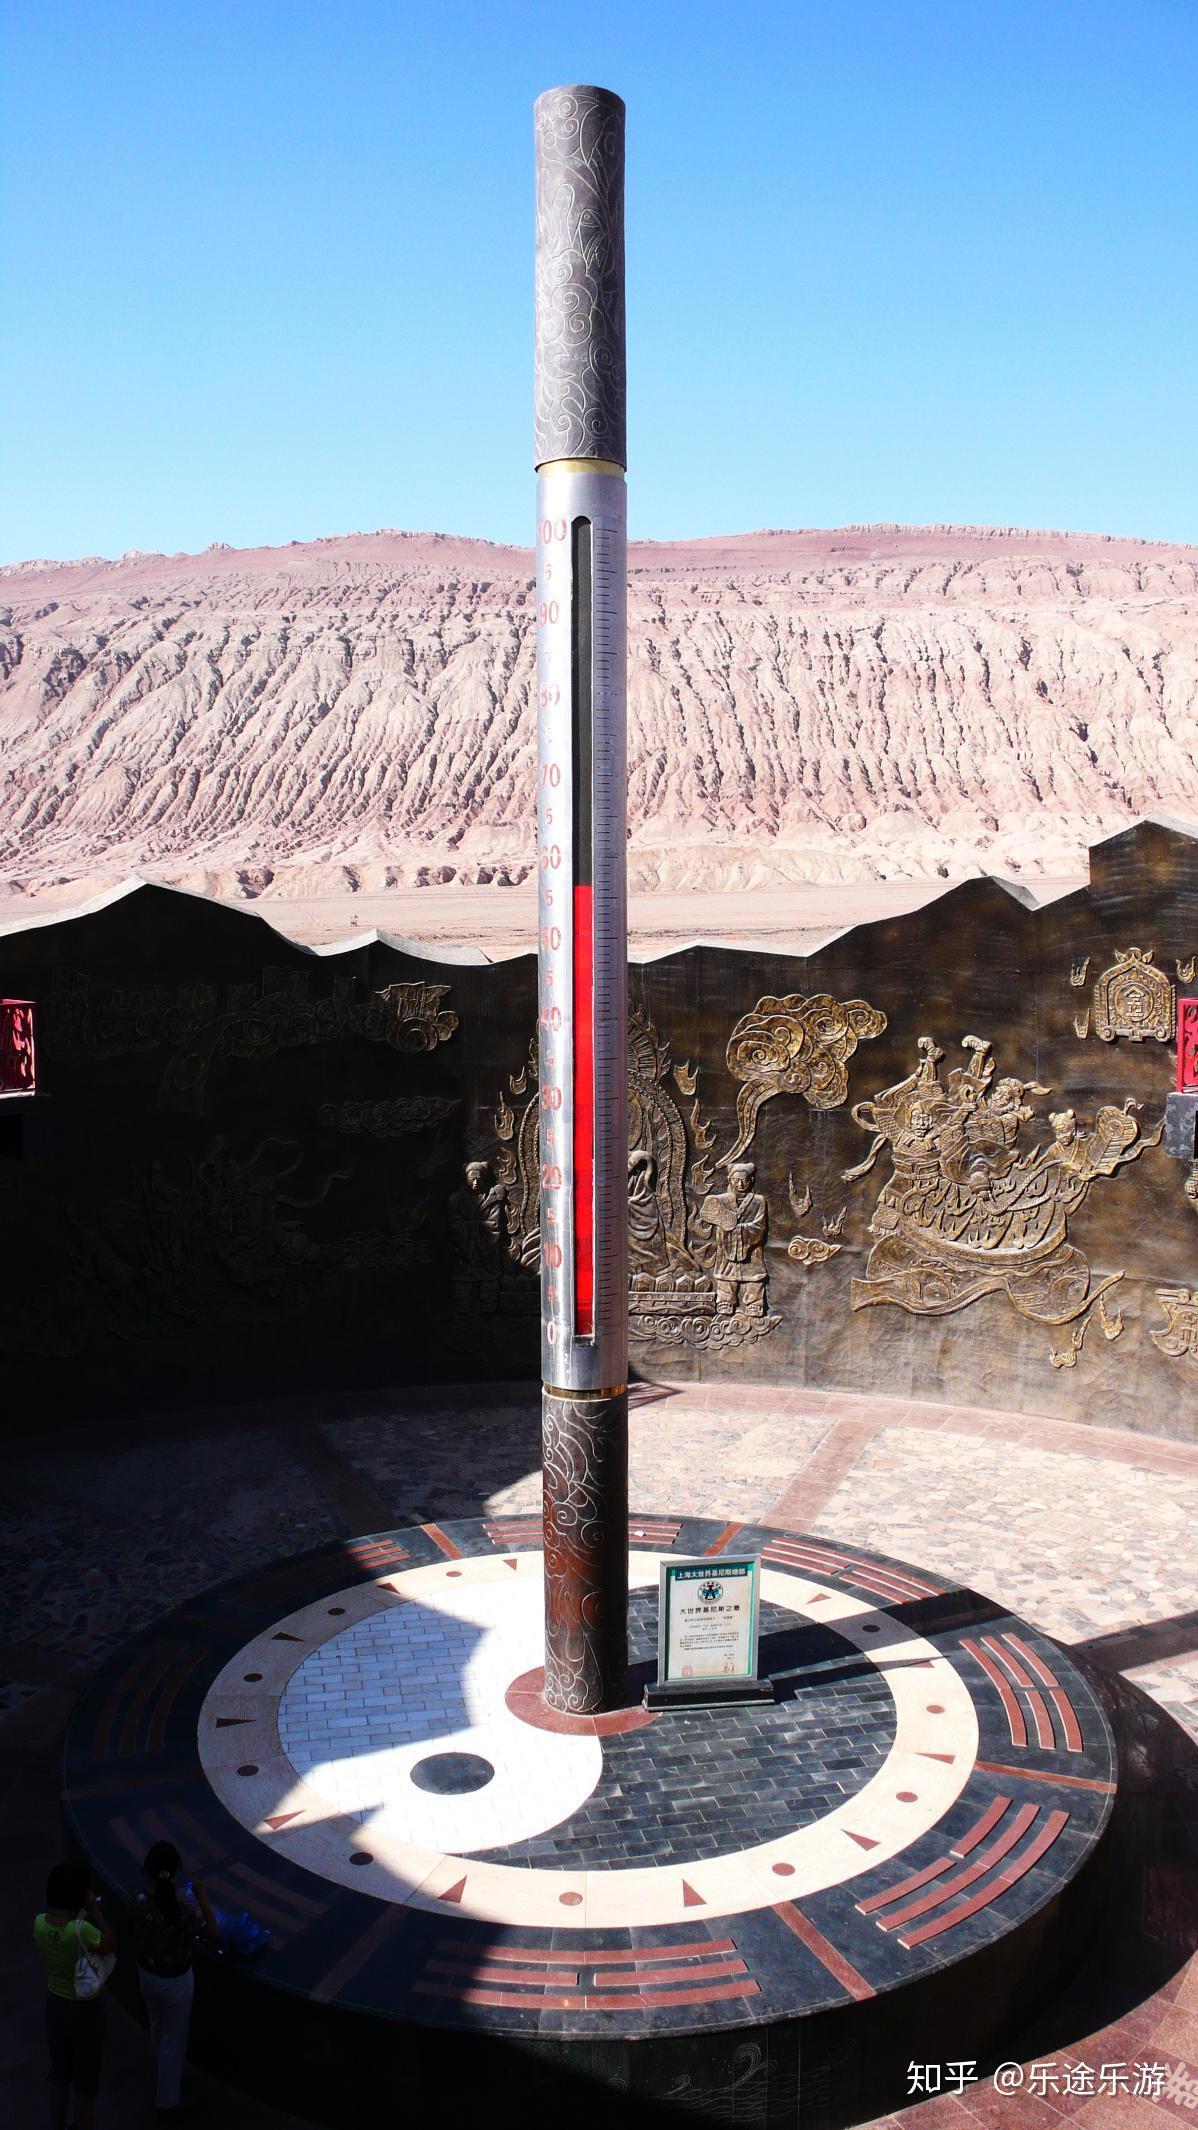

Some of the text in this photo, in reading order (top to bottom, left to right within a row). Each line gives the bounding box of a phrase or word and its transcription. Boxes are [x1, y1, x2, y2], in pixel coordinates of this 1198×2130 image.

[539, 600, 560, 626] 90
[540, 763, 561, 788] 70
[545, 808, 553, 825] 5
[540, 844, 561, 870] 60
[545, 890, 553, 906] 5
[541, 1083, 562, 1110] 30
[542, 1163, 562, 1190] 20
[543, 1242, 562, 1268] 10
[546, 1320, 557, 1345] 0
